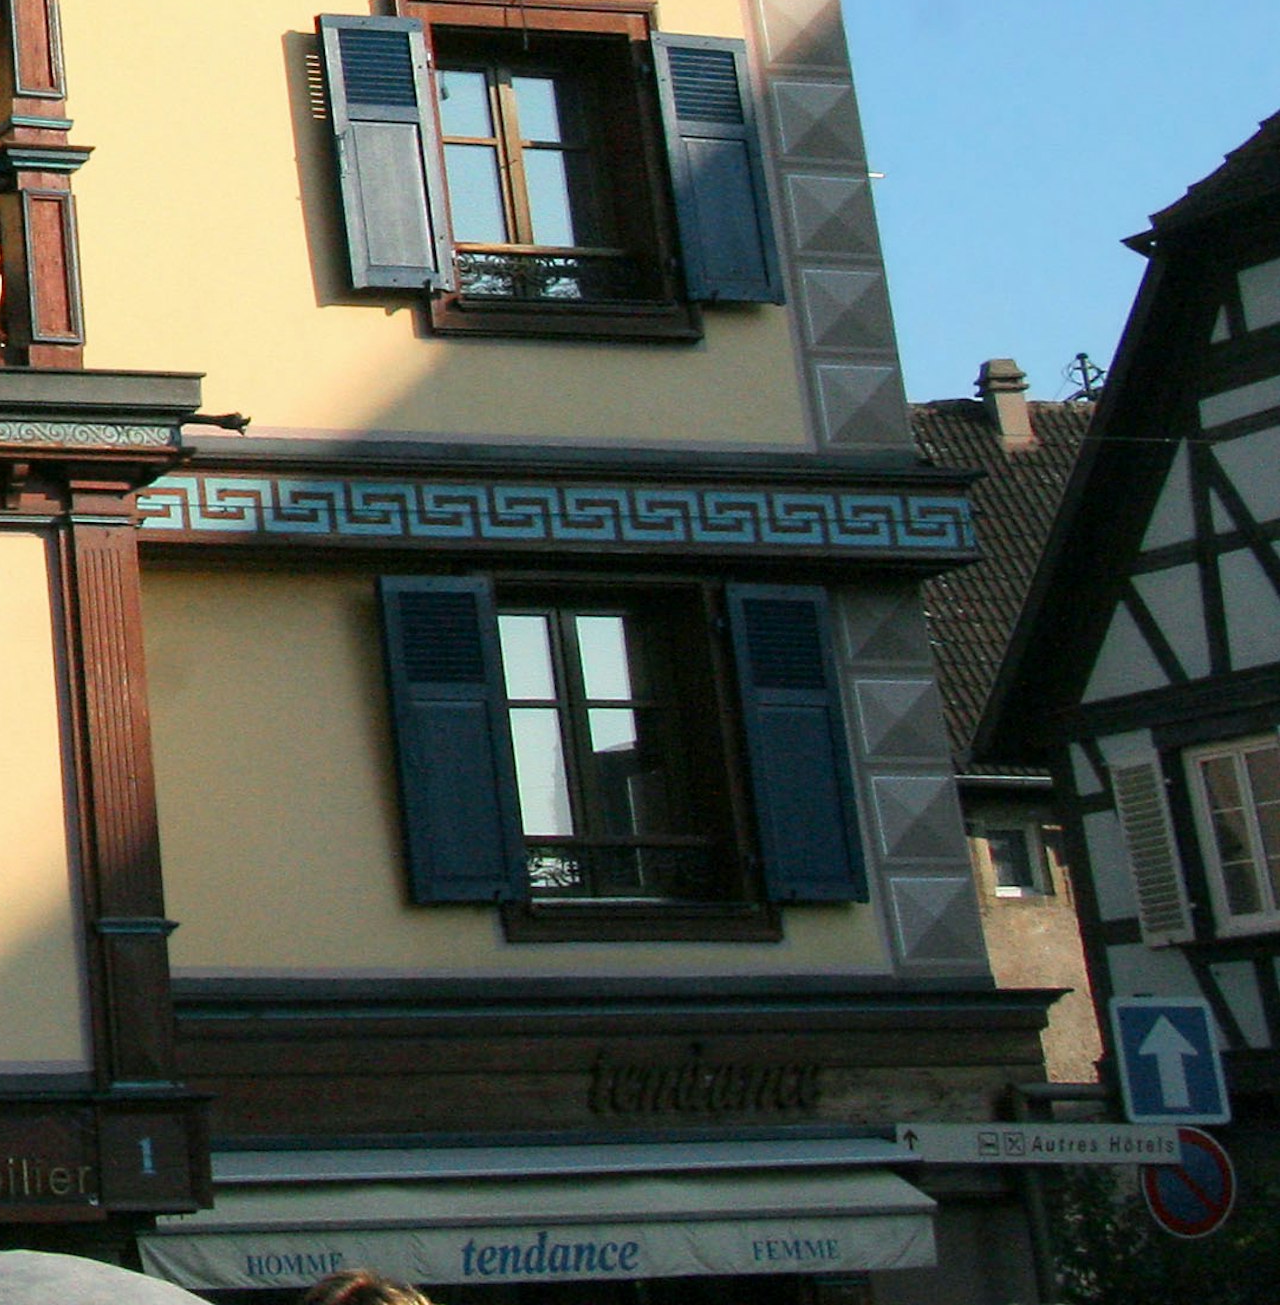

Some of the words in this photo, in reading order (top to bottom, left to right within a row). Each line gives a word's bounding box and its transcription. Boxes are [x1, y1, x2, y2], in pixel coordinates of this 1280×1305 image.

[140, 1137, 157, 1175] 1
[1031, 1135, 1098, 1153] Autres
[461, 1231, 640, 1276] tendance
[752, 1239, 839, 1262] FEMME
